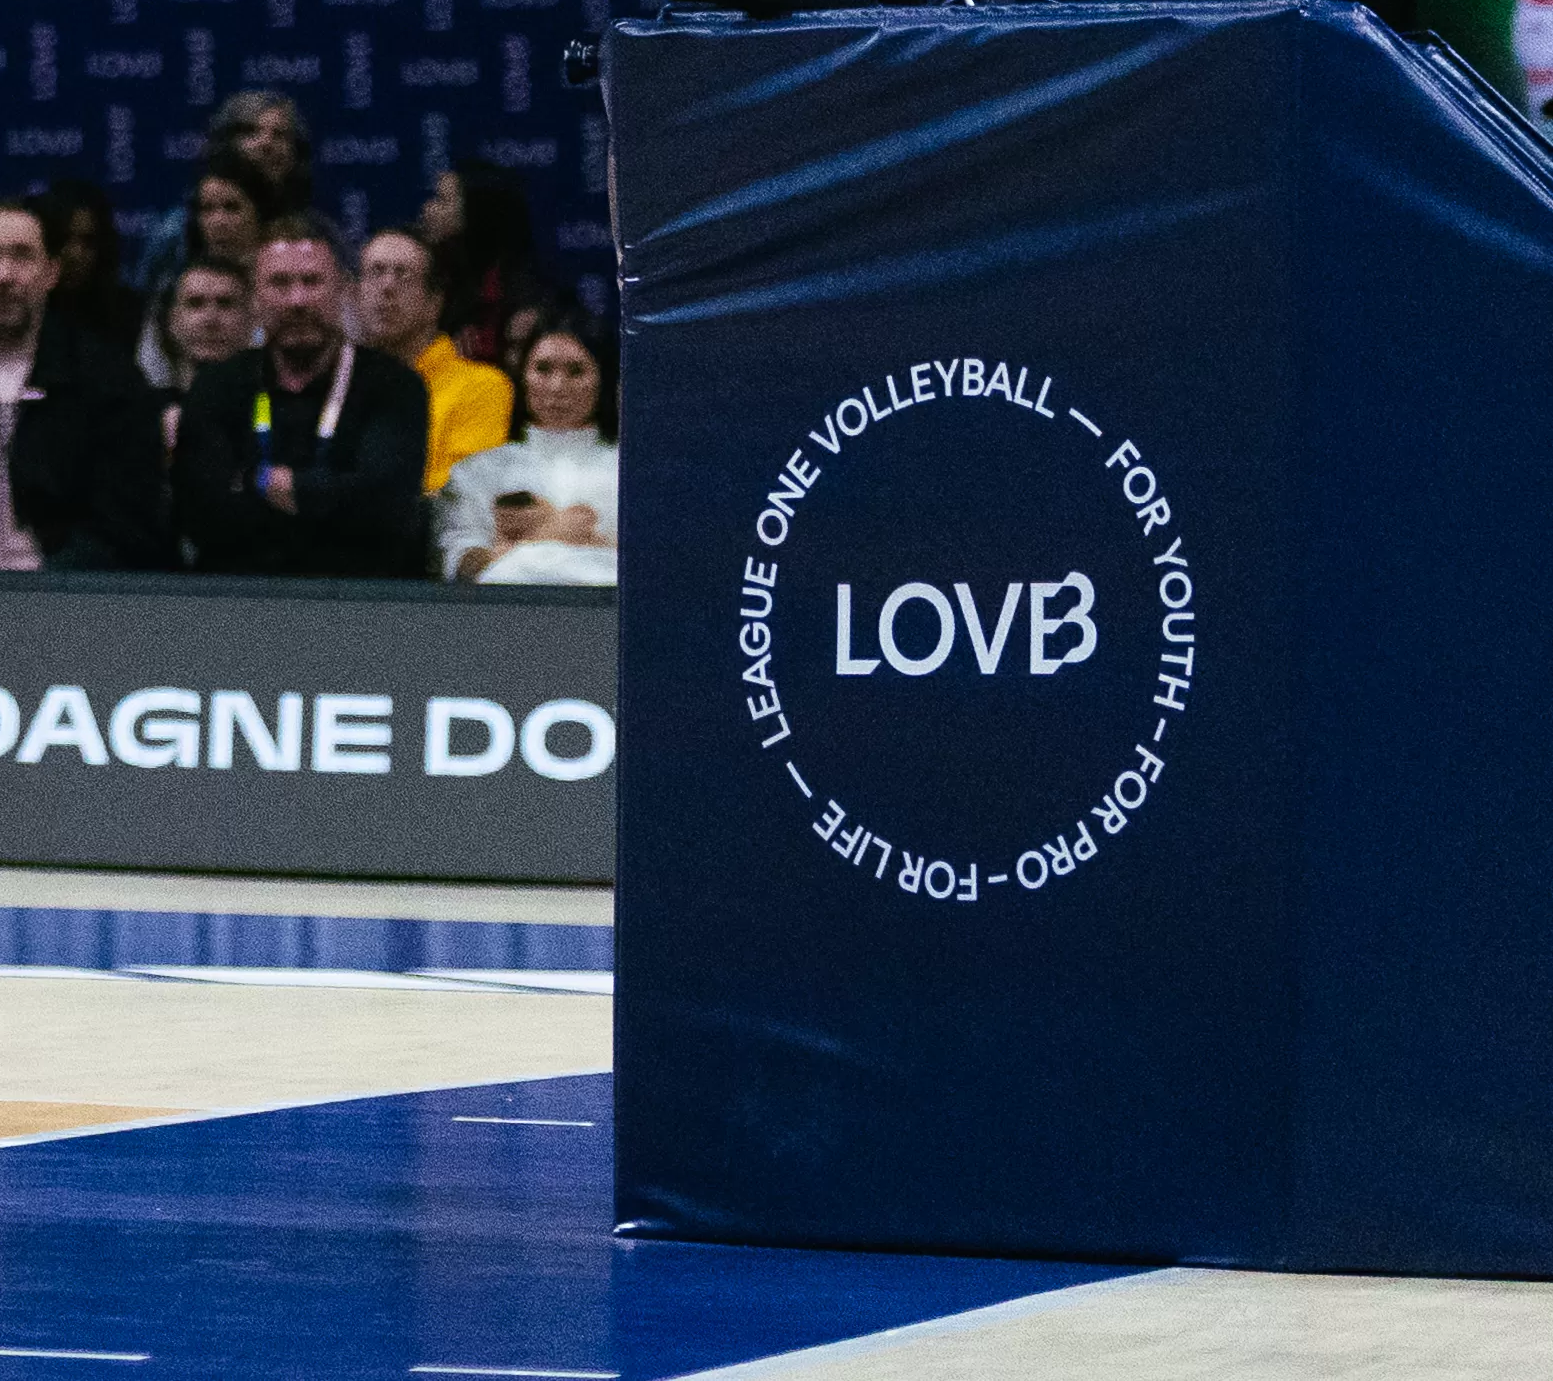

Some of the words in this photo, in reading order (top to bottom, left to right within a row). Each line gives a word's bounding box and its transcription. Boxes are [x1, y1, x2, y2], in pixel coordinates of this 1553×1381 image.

[809, 358, 1055, 455] VOLLEYBALL
[756, 449, 821, 546] ONE
[835, 571, 1098, 676] LOVB
[1105, 439, 1172, 536] FOR
[1153, 536, 1196, 712] YOUTH
[739, 556, 792, 749] LEAGUE
[1091, 744, 1166, 836] FOR
[812, 799, 893, 879] LIFE
[898, 851, 978, 902] FOR
[1016, 821, 1099, 890] PRO
